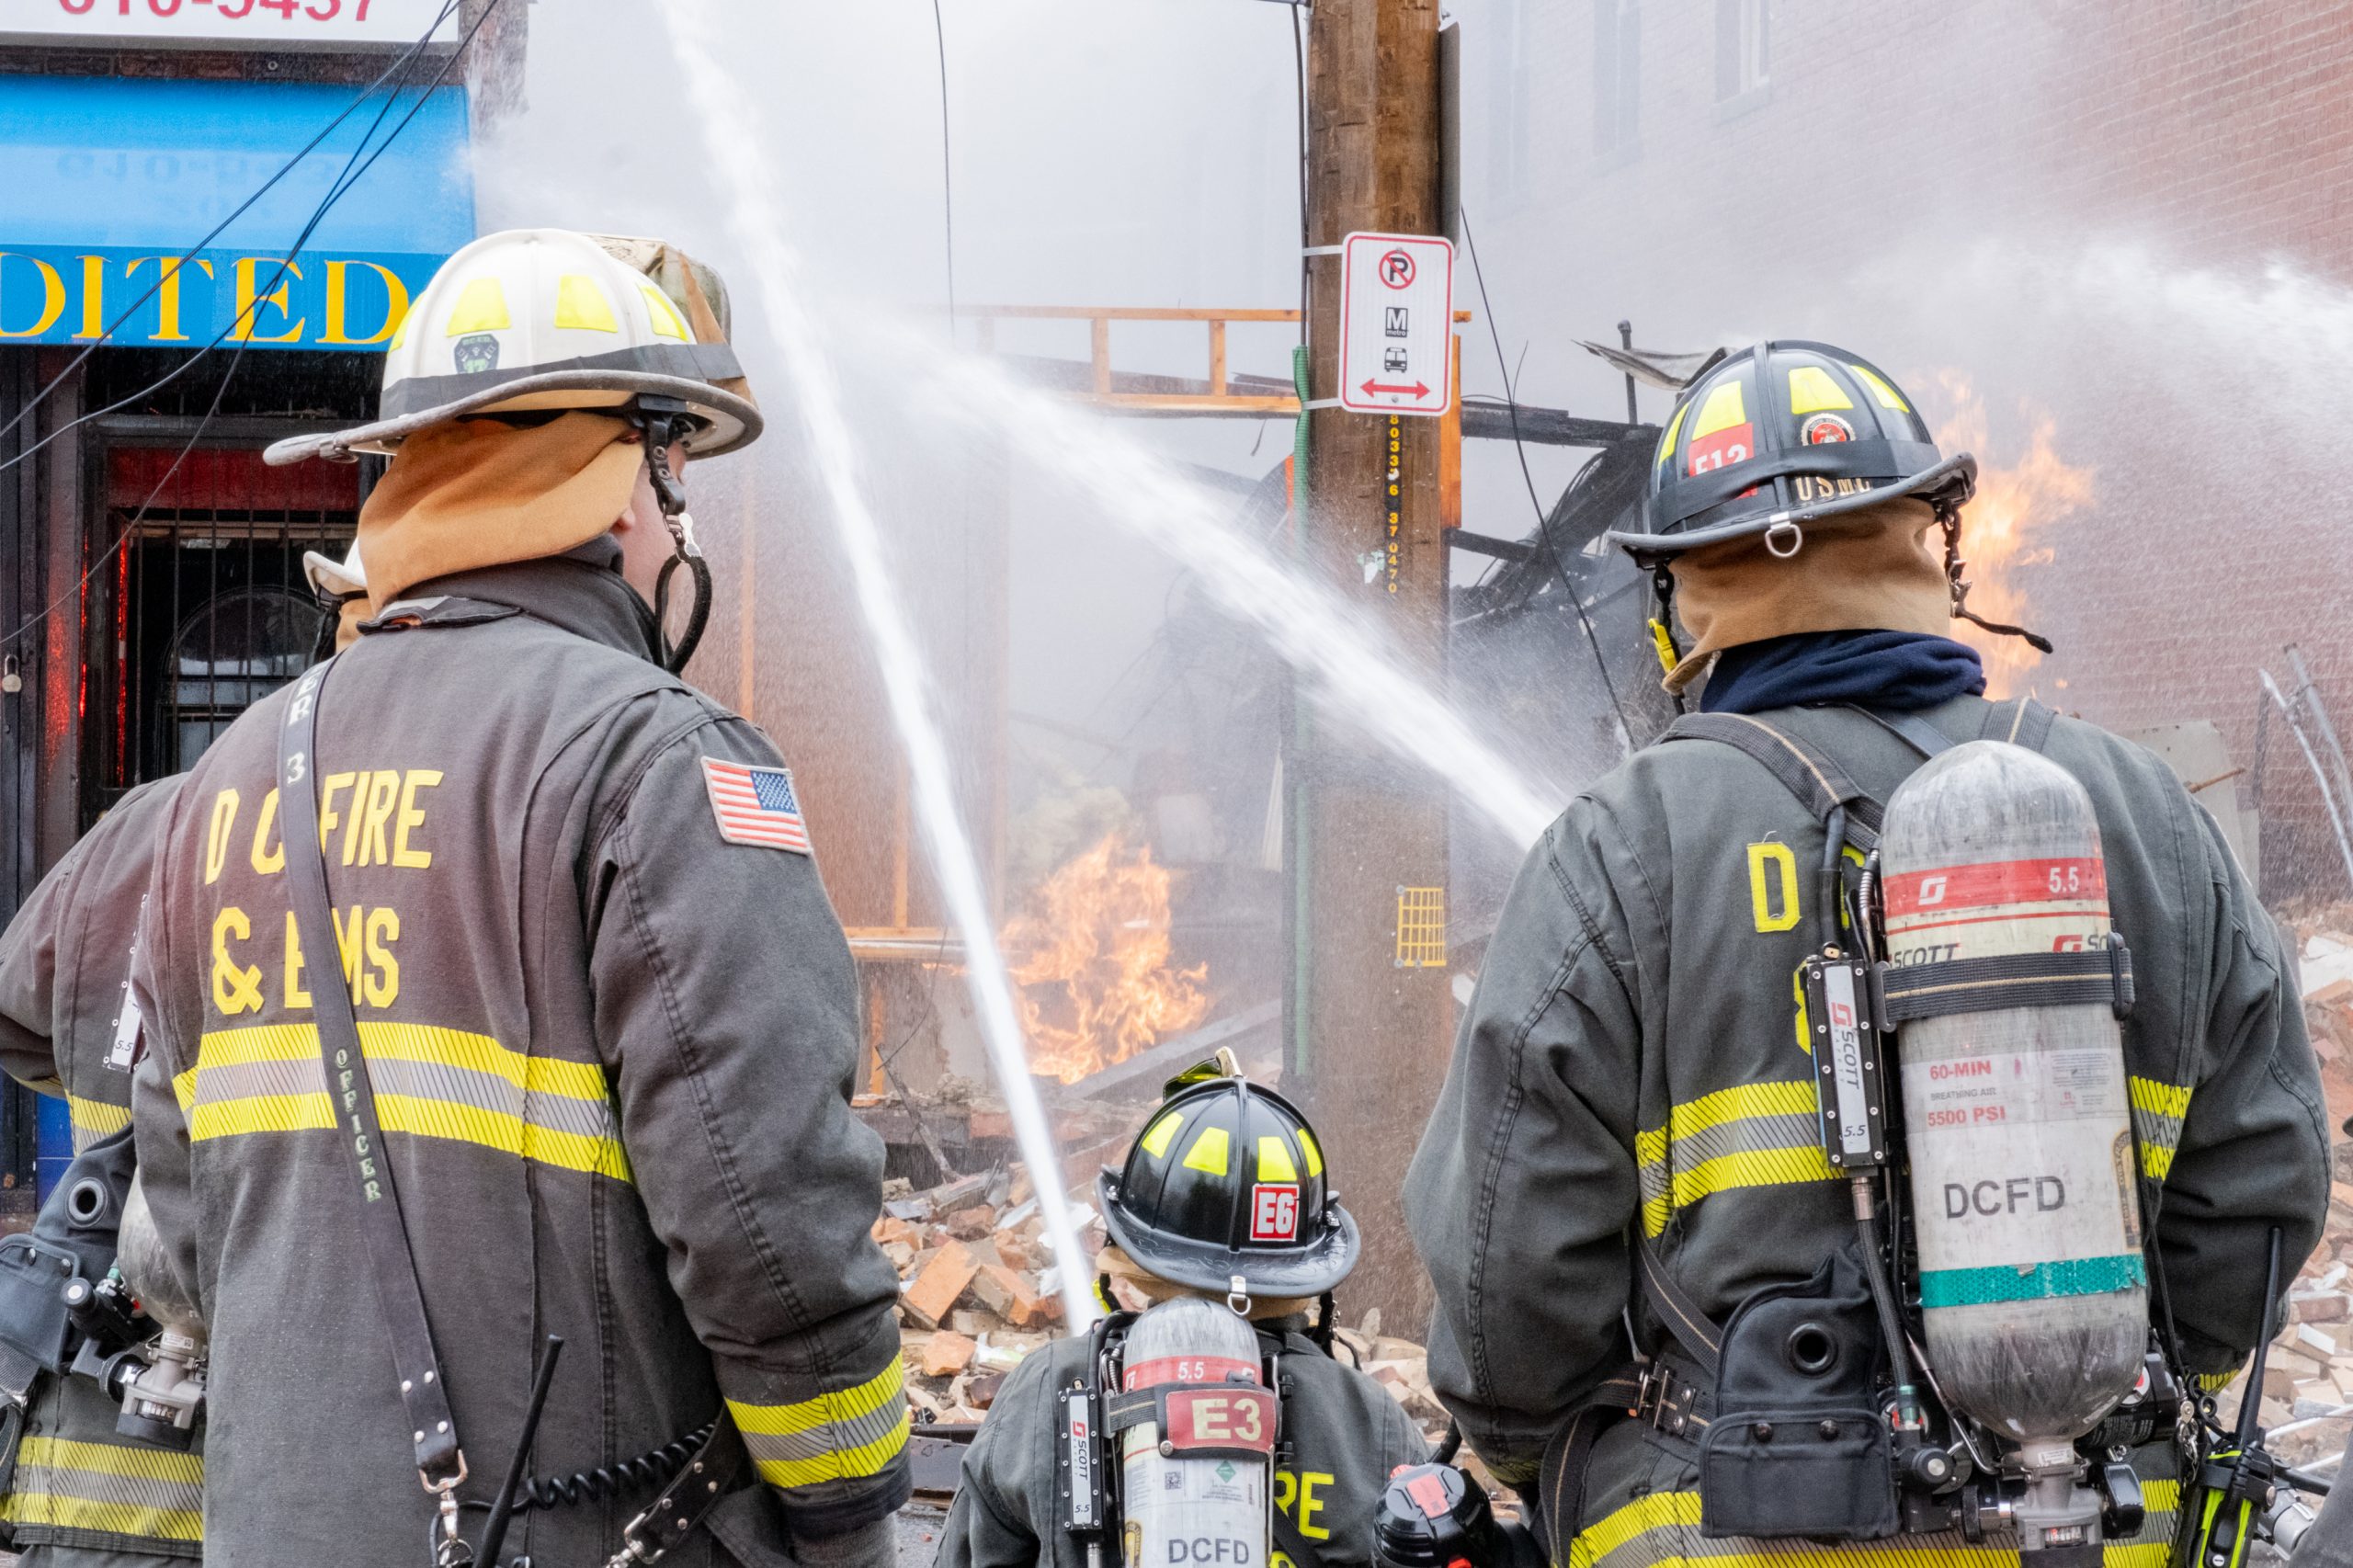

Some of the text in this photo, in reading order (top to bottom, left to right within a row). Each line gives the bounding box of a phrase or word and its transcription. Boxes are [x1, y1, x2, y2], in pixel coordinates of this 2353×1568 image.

[0, 252, 410, 345] DITED
[1795, 476, 1871, 502] USMC
[287, 751, 305, 785] 3
[205, 788, 240, 883] D
[320, 769, 444, 869] FIRE
[1747, 841, 1802, 933] D
[2048, 867, 2079, 893] 5.5
[212, 904, 400, 1016] & EMS
[1893, 942, 1960, 968] SCOTT
[115, 1040, 134, 1051] 5.5
[1841, 1030, 1860, 1090] SCOTT
[1929, 1060, 1992, 1081] 60-MIN
[1930, 1086, 1996, 1102] BREATHING AIR
[335, 1048, 382, 1203] OFFICER
[1844, 1124, 1866, 1137] 5.5
[1927, 1106, 2006, 1127] 5500 PSI
[1256, 1191, 1295, 1234] E6
[1944, 1176, 2065, 1220] DCFD
[1177, 1361, 1204, 1380] 5.5
[1191, 1397, 1263, 1442] E3
[1077, 1439, 1088, 1481] SCOTT
[1074, 1504, 1090, 1514] 5.5
[1168, 1538, 1250, 1564] DCFD
